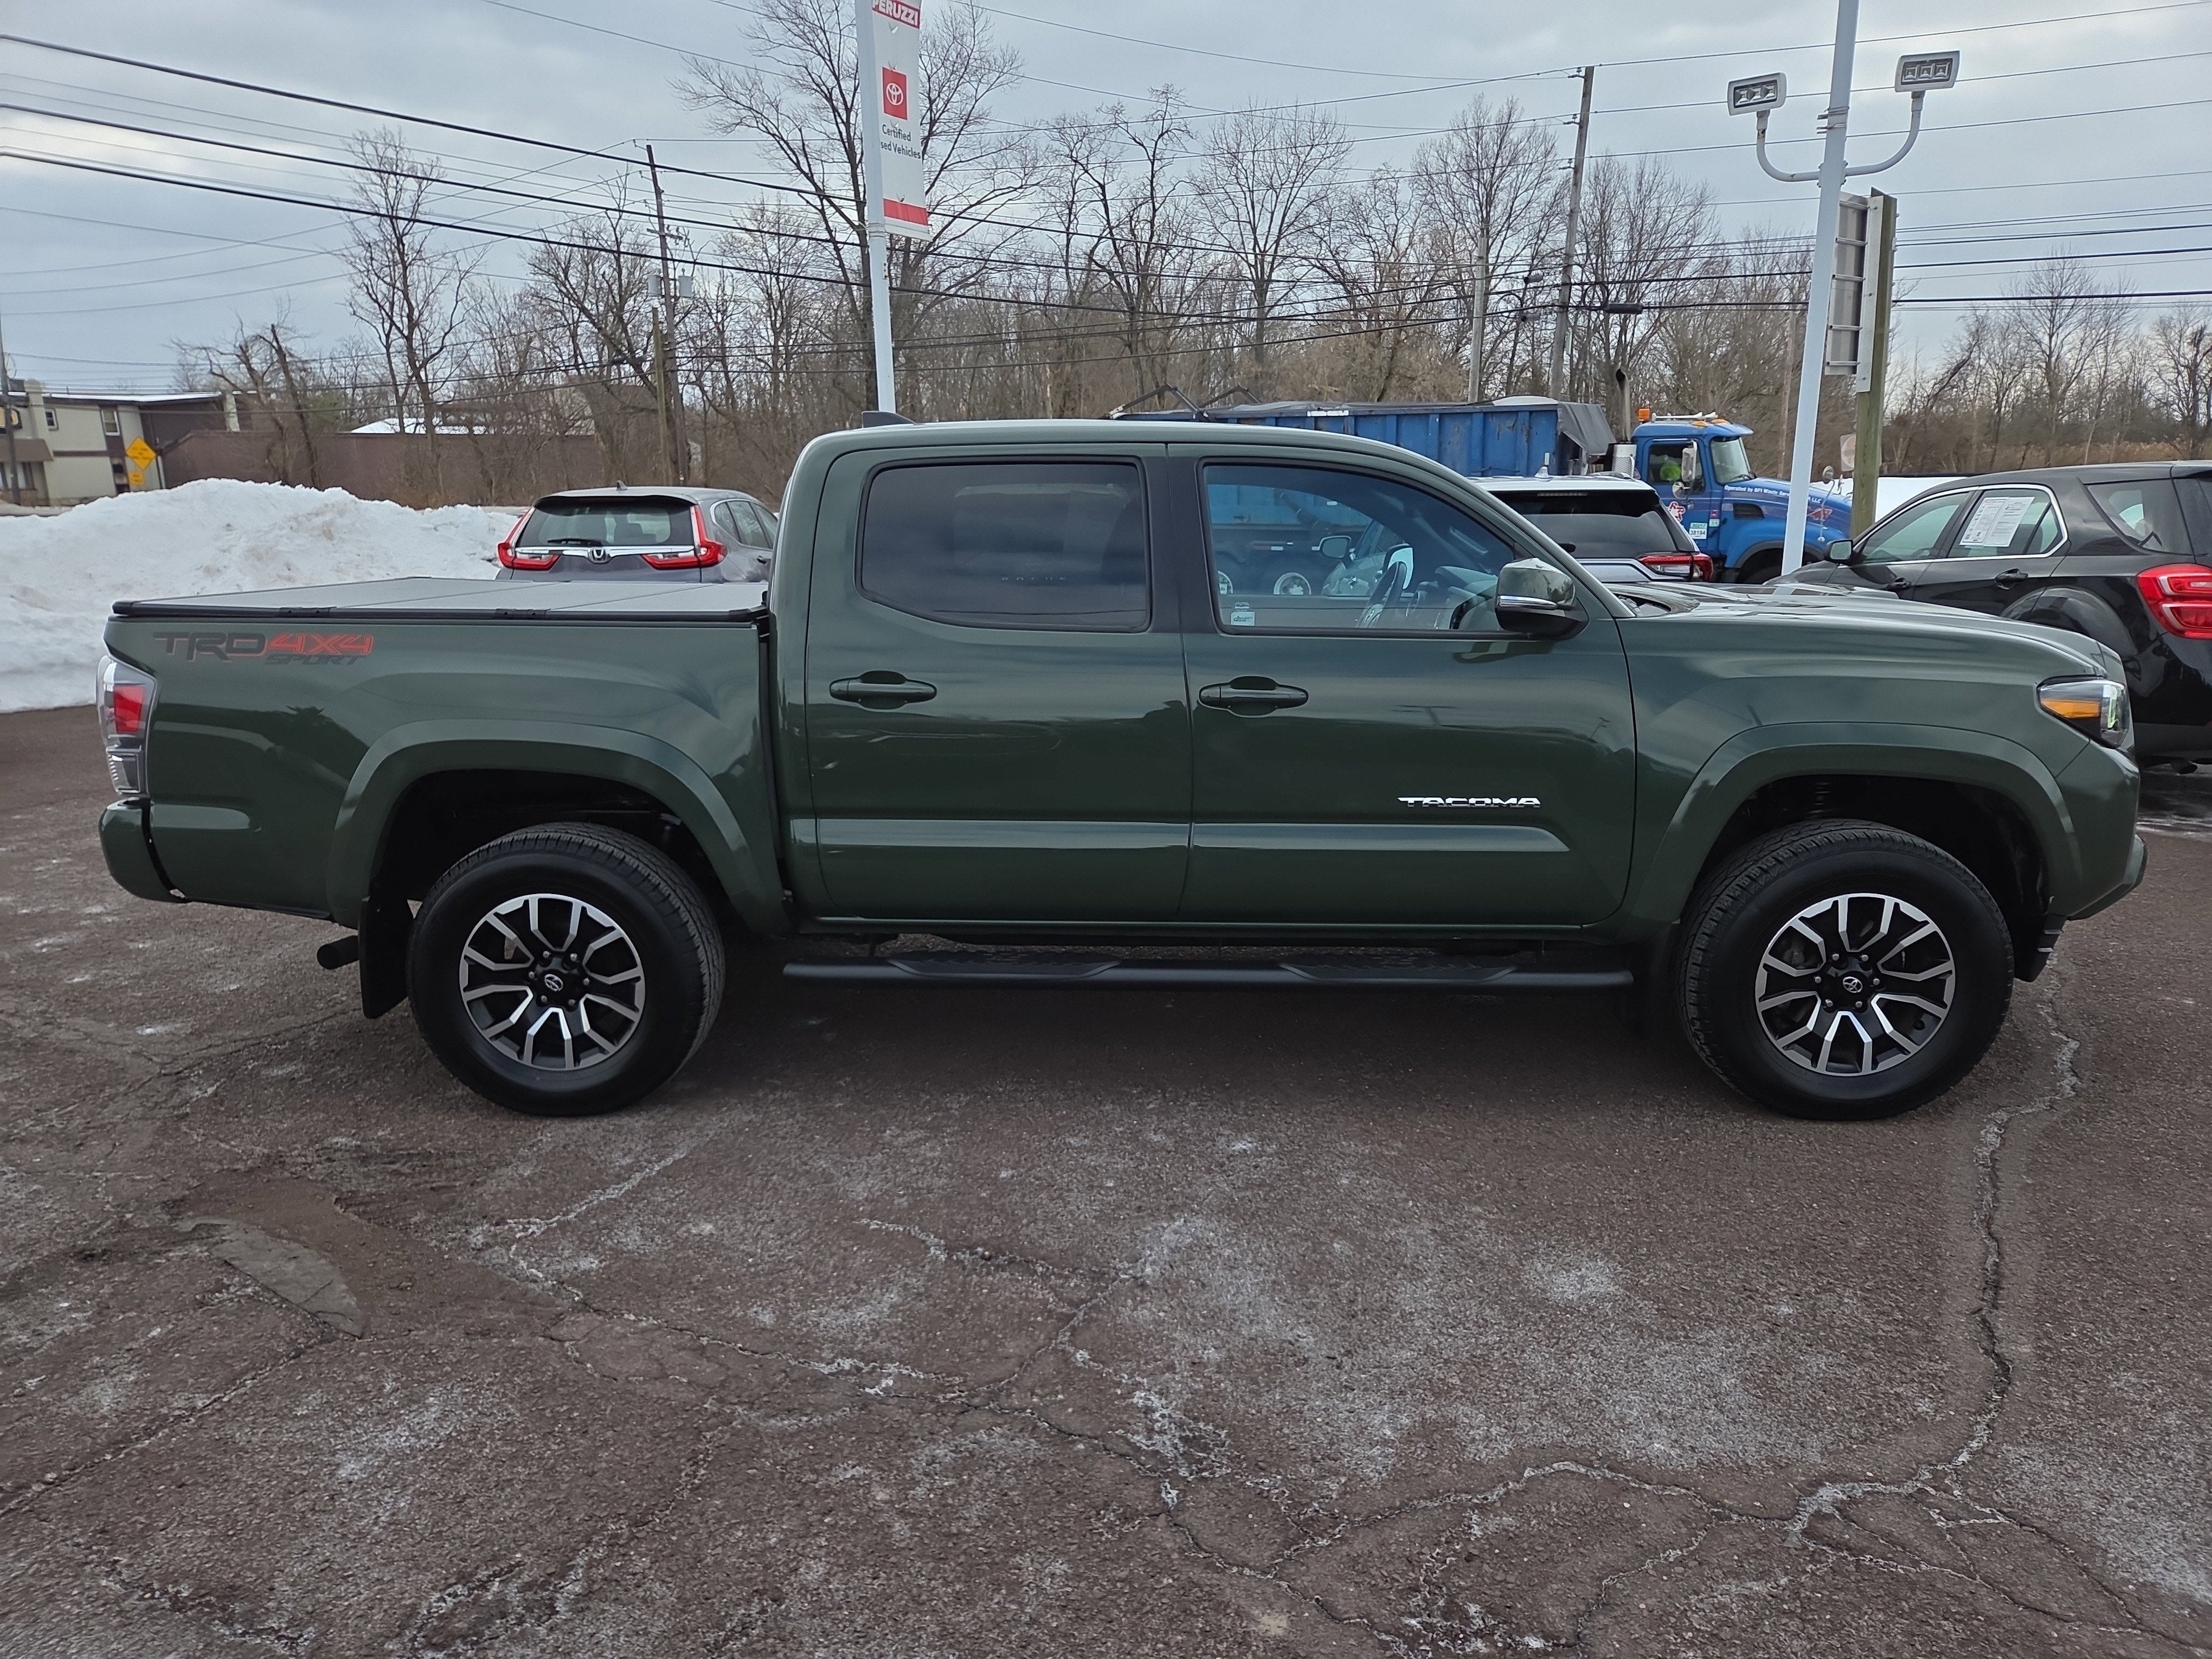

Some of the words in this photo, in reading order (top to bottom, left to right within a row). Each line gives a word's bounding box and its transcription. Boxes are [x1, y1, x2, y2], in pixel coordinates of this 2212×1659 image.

[882, 124, 911, 142] Certified
[880, 140, 892, 151] sed
[892, 142, 921, 159] Vehicles
[153, 632, 266, 663] TRD
[265, 655, 365, 665] SPORT
[1397, 796, 1541, 807] TACOMA
